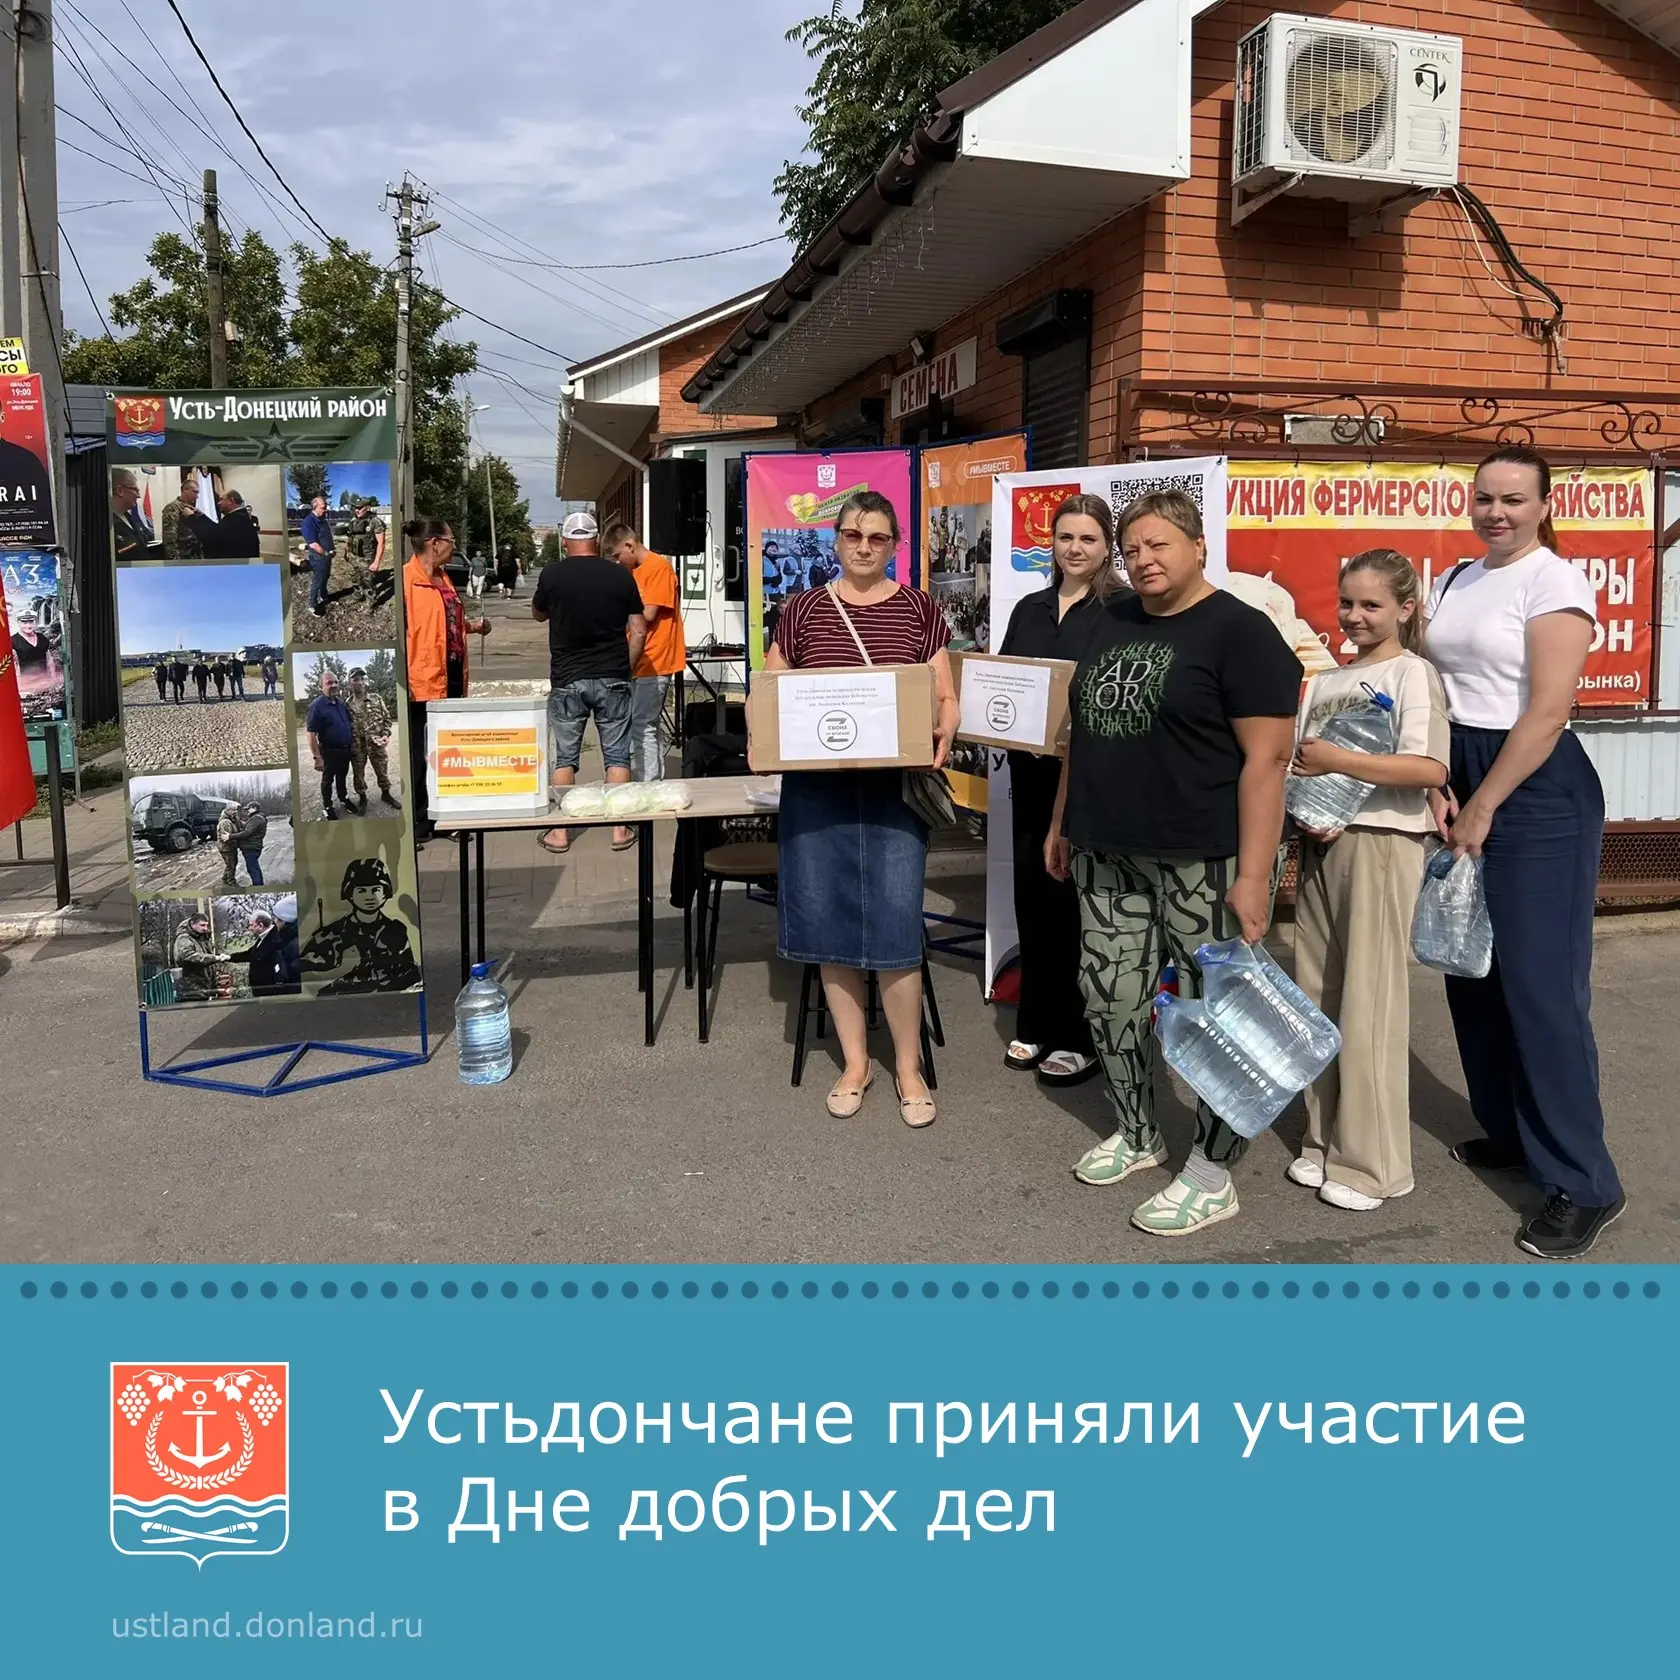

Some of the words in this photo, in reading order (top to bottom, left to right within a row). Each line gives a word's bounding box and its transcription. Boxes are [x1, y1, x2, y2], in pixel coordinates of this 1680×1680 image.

[1410, 48, 1452, 64] CENTEK
[0, 349, 22, 361] СЫ
[0, 364, 18, 374] ГО
[900, 352, 958, 413] СЕМЕНА
[11, 388, 32, 397] 19:00
[969, 461, 1010, 475] #МЫВМЕСТЕ
[442, 755, 537, 768] #МЫВМЕСТЕ
